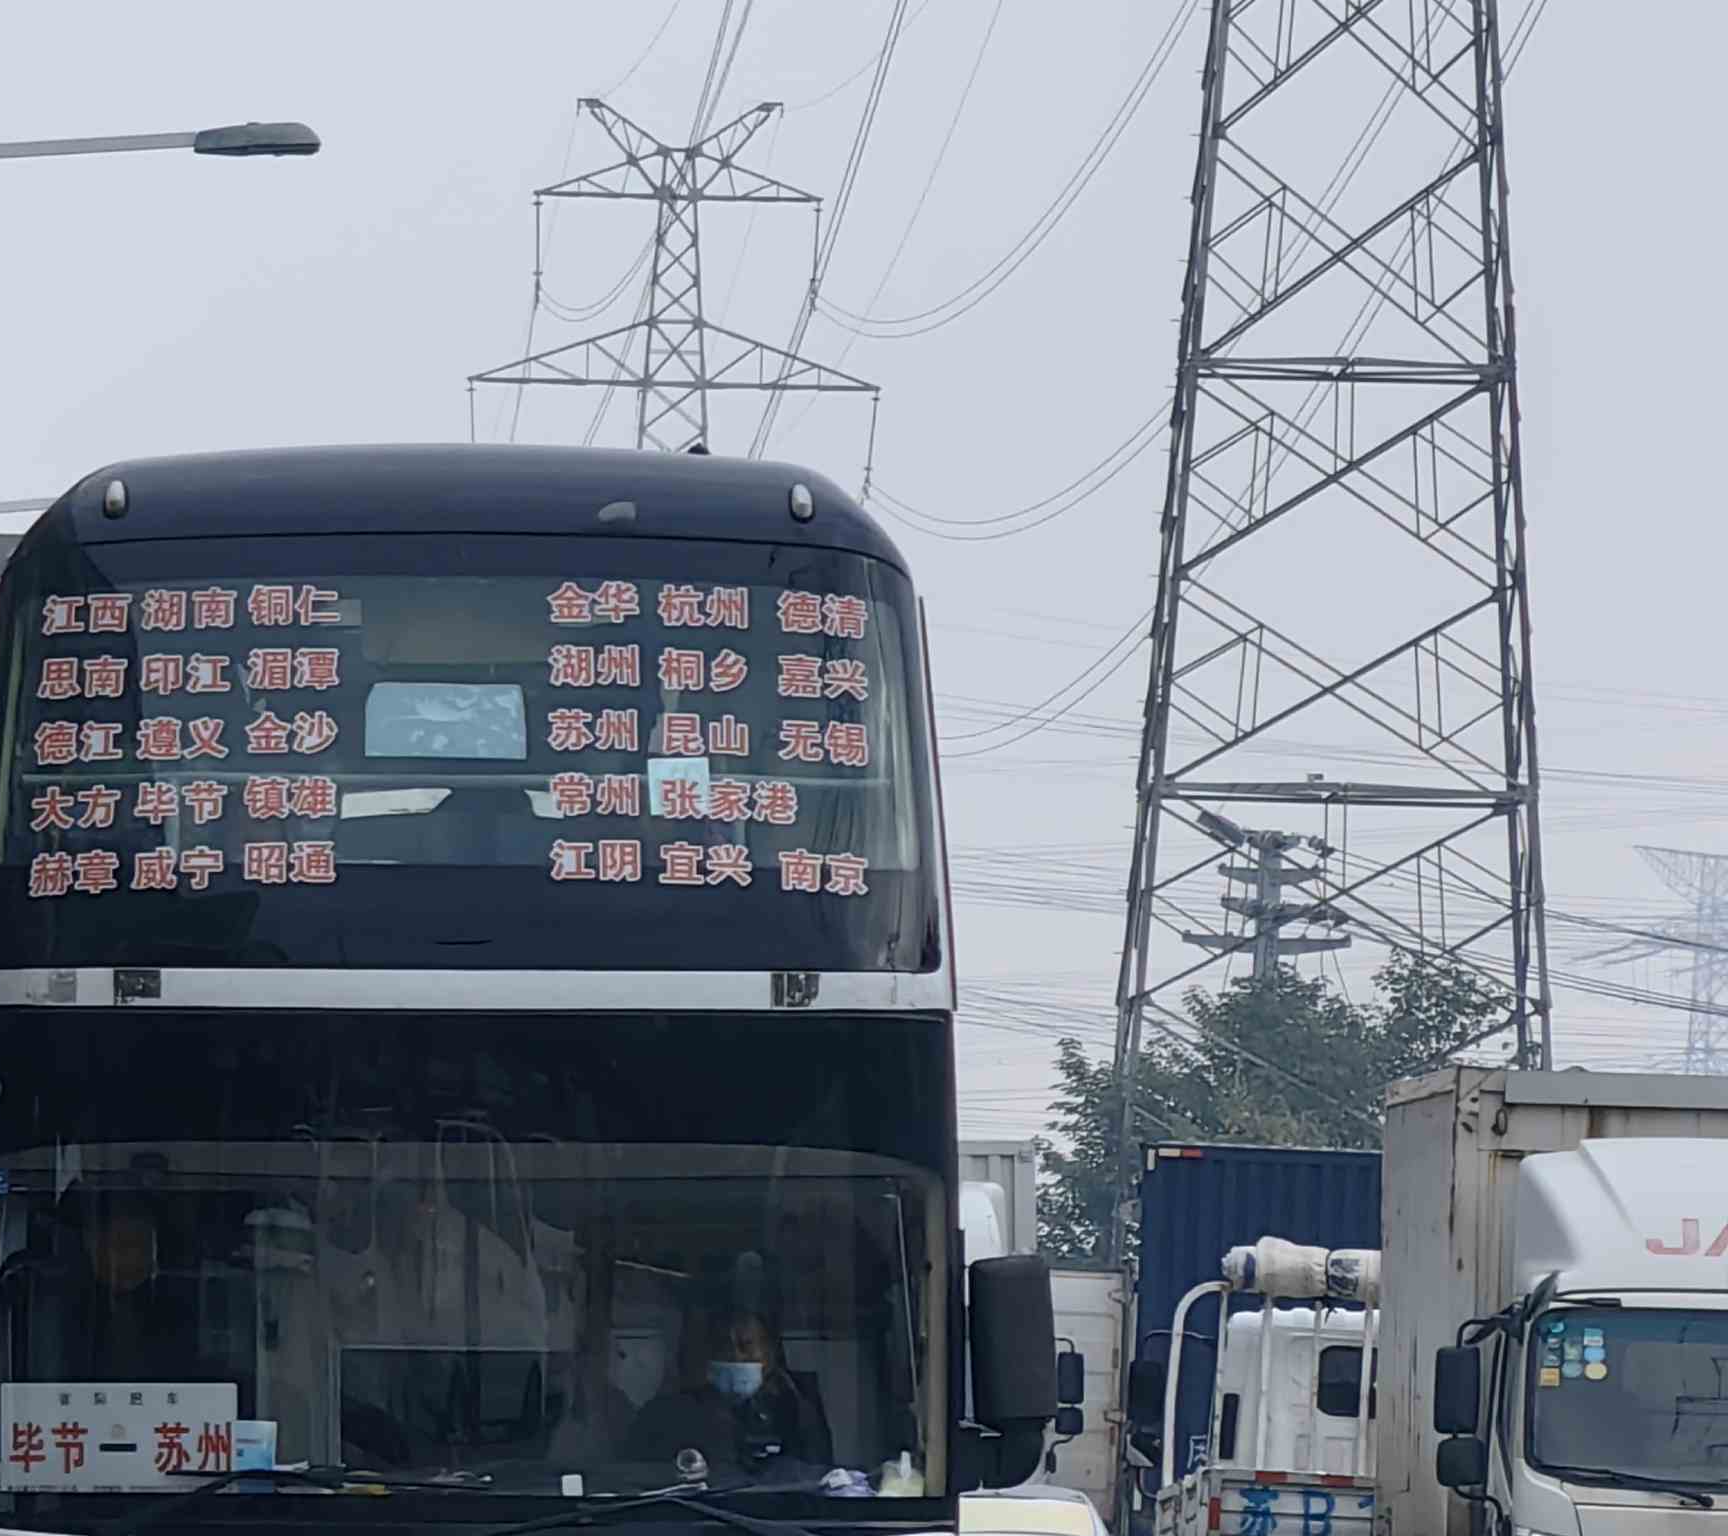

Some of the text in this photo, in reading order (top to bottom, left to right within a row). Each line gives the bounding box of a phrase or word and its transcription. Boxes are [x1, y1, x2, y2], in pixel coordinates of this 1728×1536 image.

[42, 585, 341, 635] 江西 湖南 铜仁
[547, 581, 868, 639] 金华 杭州 德清
[37, 648, 339, 699] 思南 印江 湄潭
[548, 644, 869, 701] 湖州 桐乡 嘉兴
[35, 711, 338, 764] 德江 遵义 金沙
[548, 708, 869, 766] 苏州 昆山 无锡
[31, 776, 337, 832] 大方 毕节 镇雄
[549, 772, 799, 824] 常州 张家港
[29, 840, 336, 897] 赫章 威宁 昭通
[548, 839, 869, 895] 江阴 宜兴 南京
